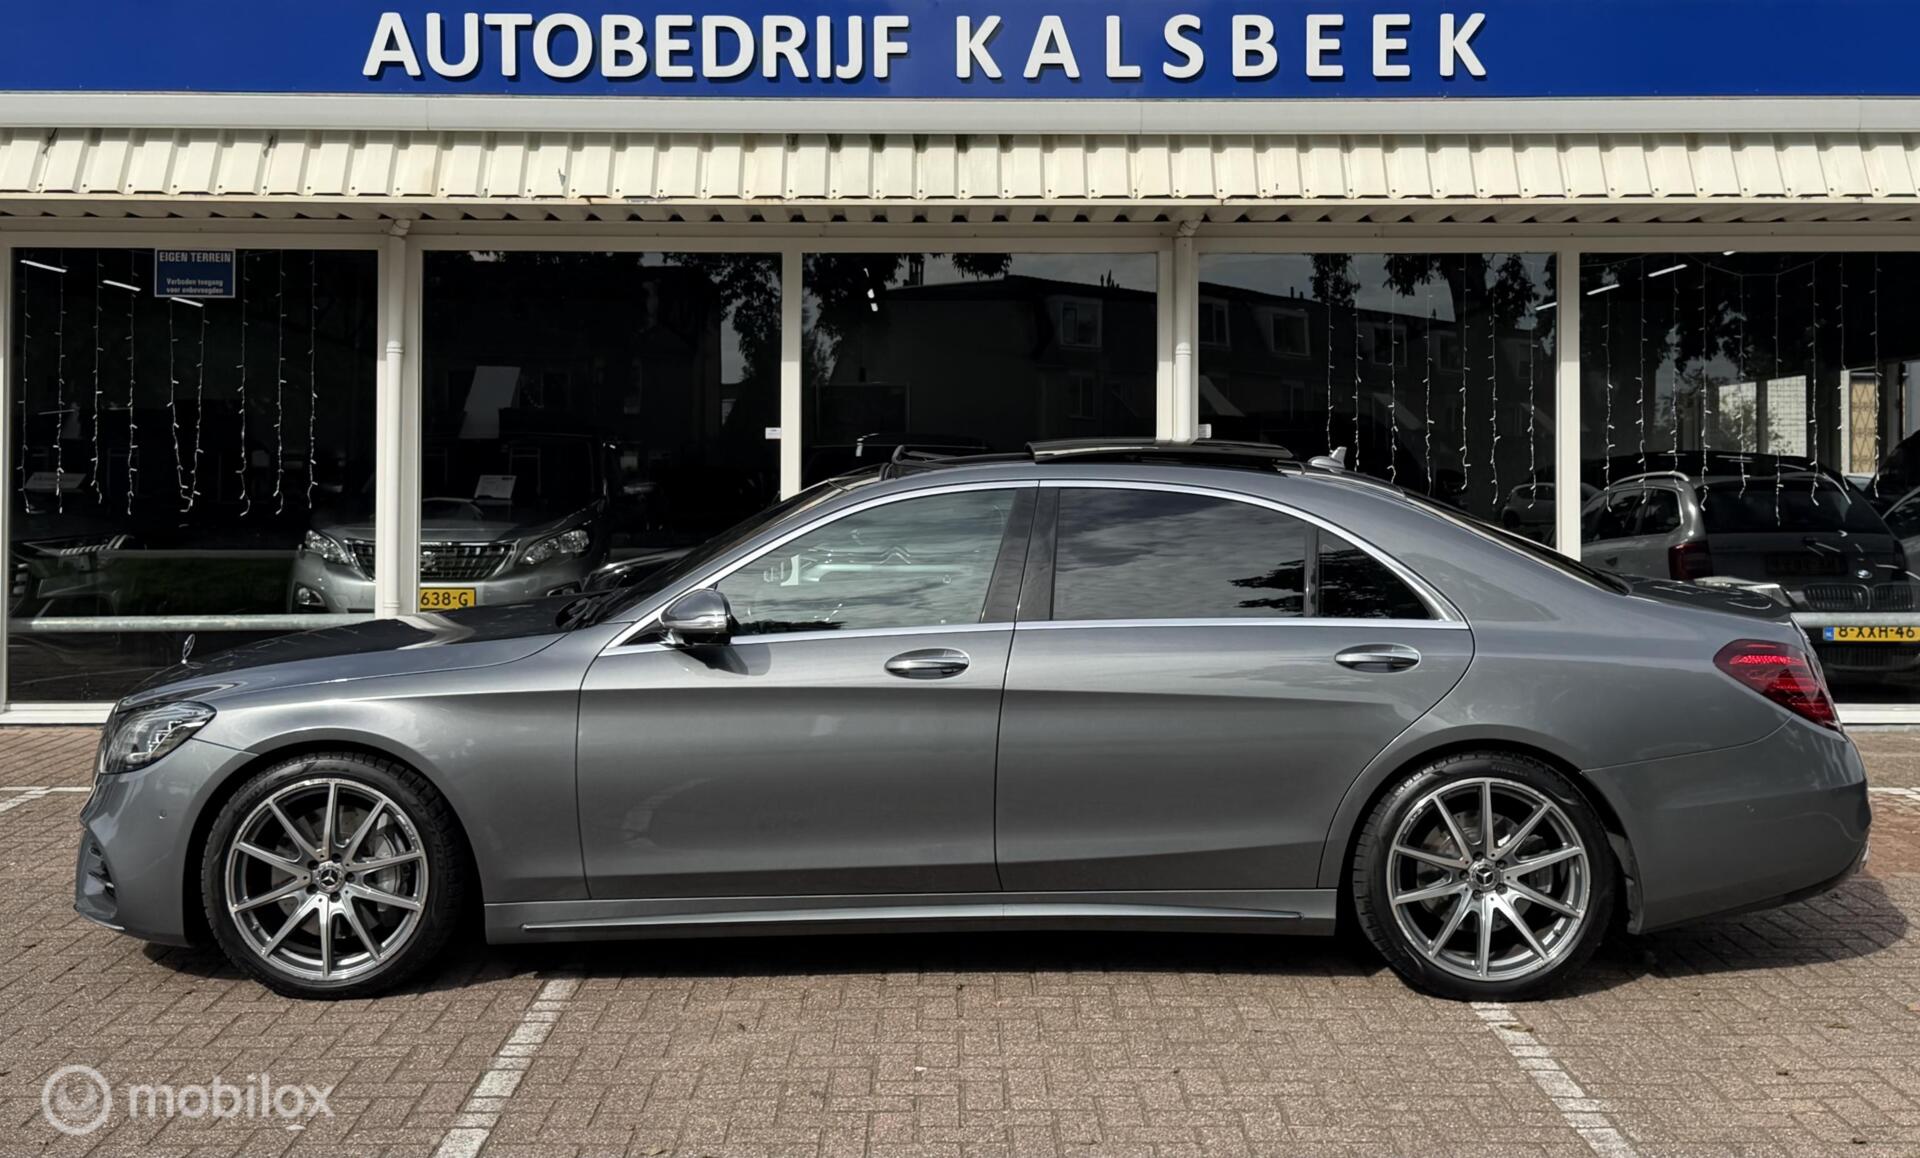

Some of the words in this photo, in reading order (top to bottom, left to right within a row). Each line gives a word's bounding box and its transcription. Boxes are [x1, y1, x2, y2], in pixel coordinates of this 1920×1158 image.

[363, 13, 908, 77] AUTOBEDRIJF
[956, 13, 1486, 77] KALSBEEK
[160, 251, 188, 262] EIGEN
[190, 252, 231, 263] TERREIN
[166, 278, 196, 286] Verboden
